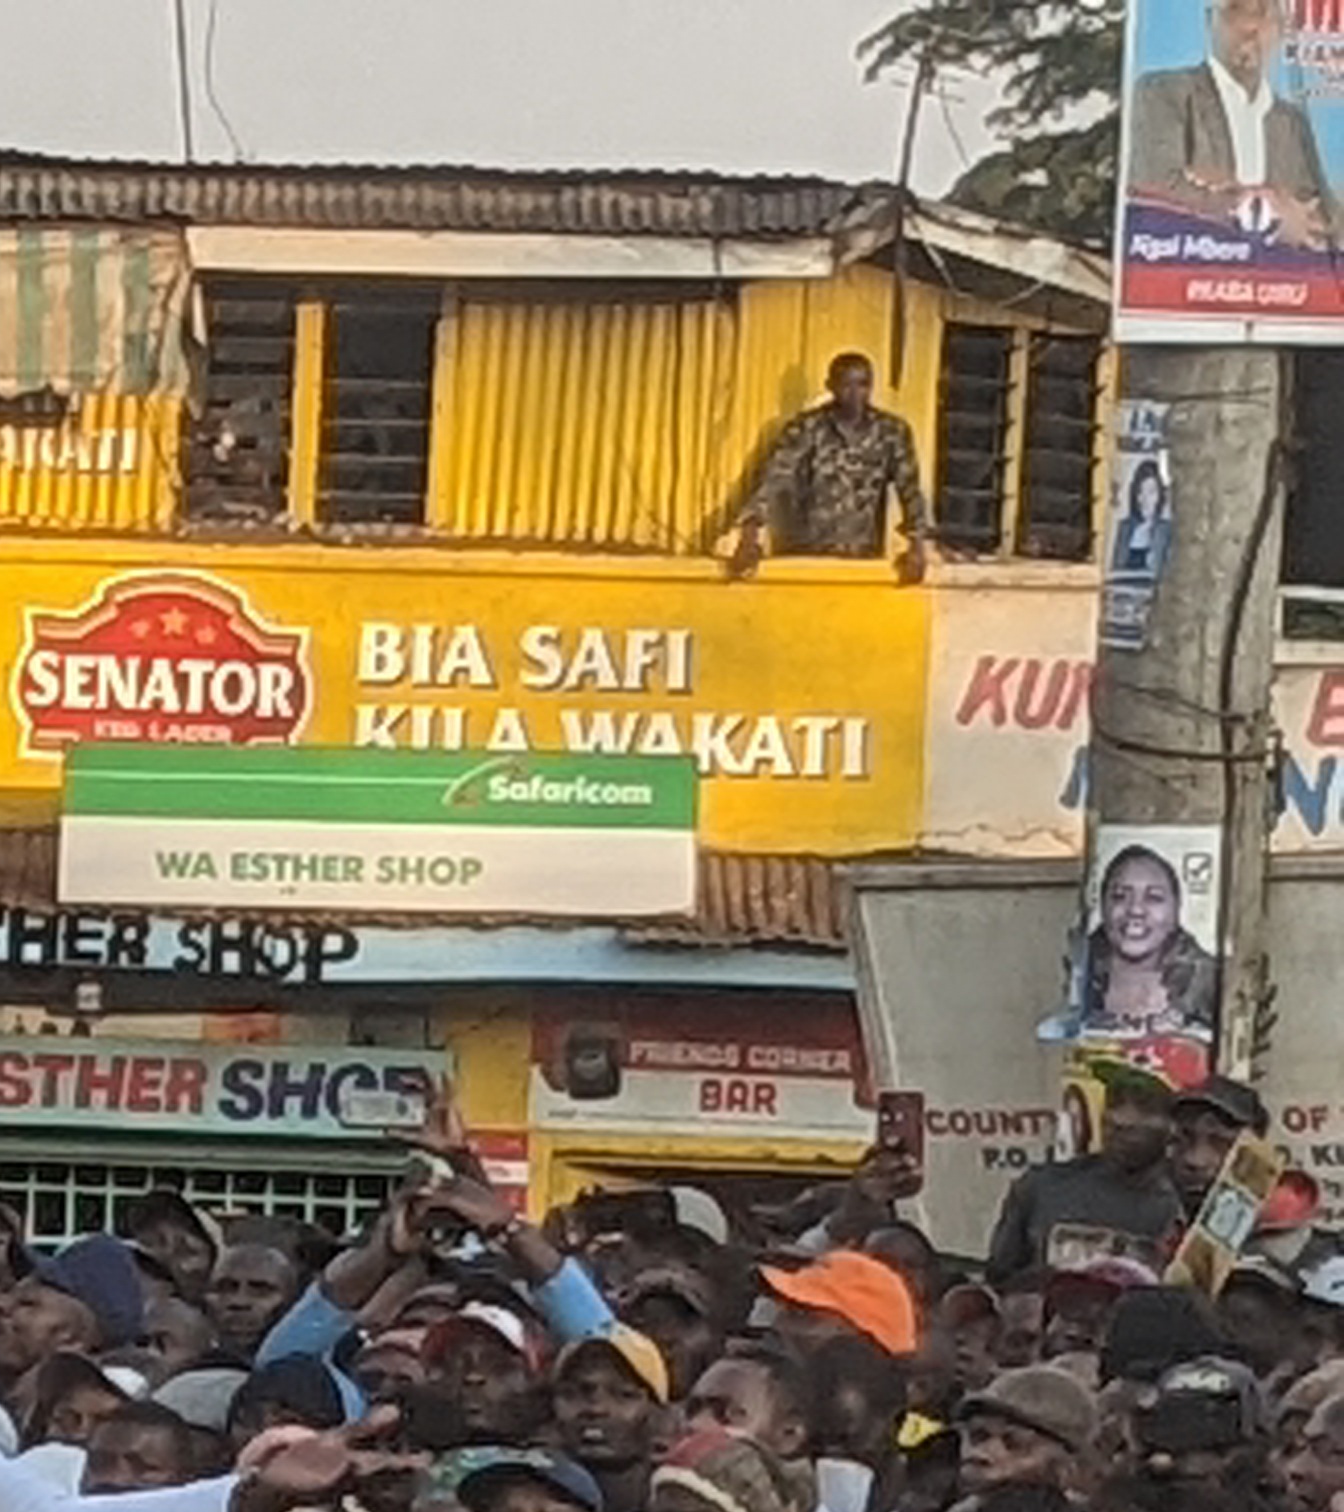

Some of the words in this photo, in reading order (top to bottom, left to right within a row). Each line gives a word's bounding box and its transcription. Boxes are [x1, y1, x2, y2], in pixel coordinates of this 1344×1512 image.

[356, 621, 496, 688] BIA
[519, 625, 693, 693] SAFI
[24, 650, 295, 718] SENATOR
[559, 707, 868, 779] WAKATI
[486, 773, 653, 807] Safaricom
[155, 849, 218, 880] WA
[229, 851, 364, 884] ESTHER
[375, 855, 483, 888] SHOP
[174, 919, 361, 983] SHOP
[628, 1041, 740, 1069] FRIENDS
[748, 1046, 854, 1074] CORNER
[699, 1080, 778, 1116] BAR
[1282, 1106, 1329, 1135] OF
